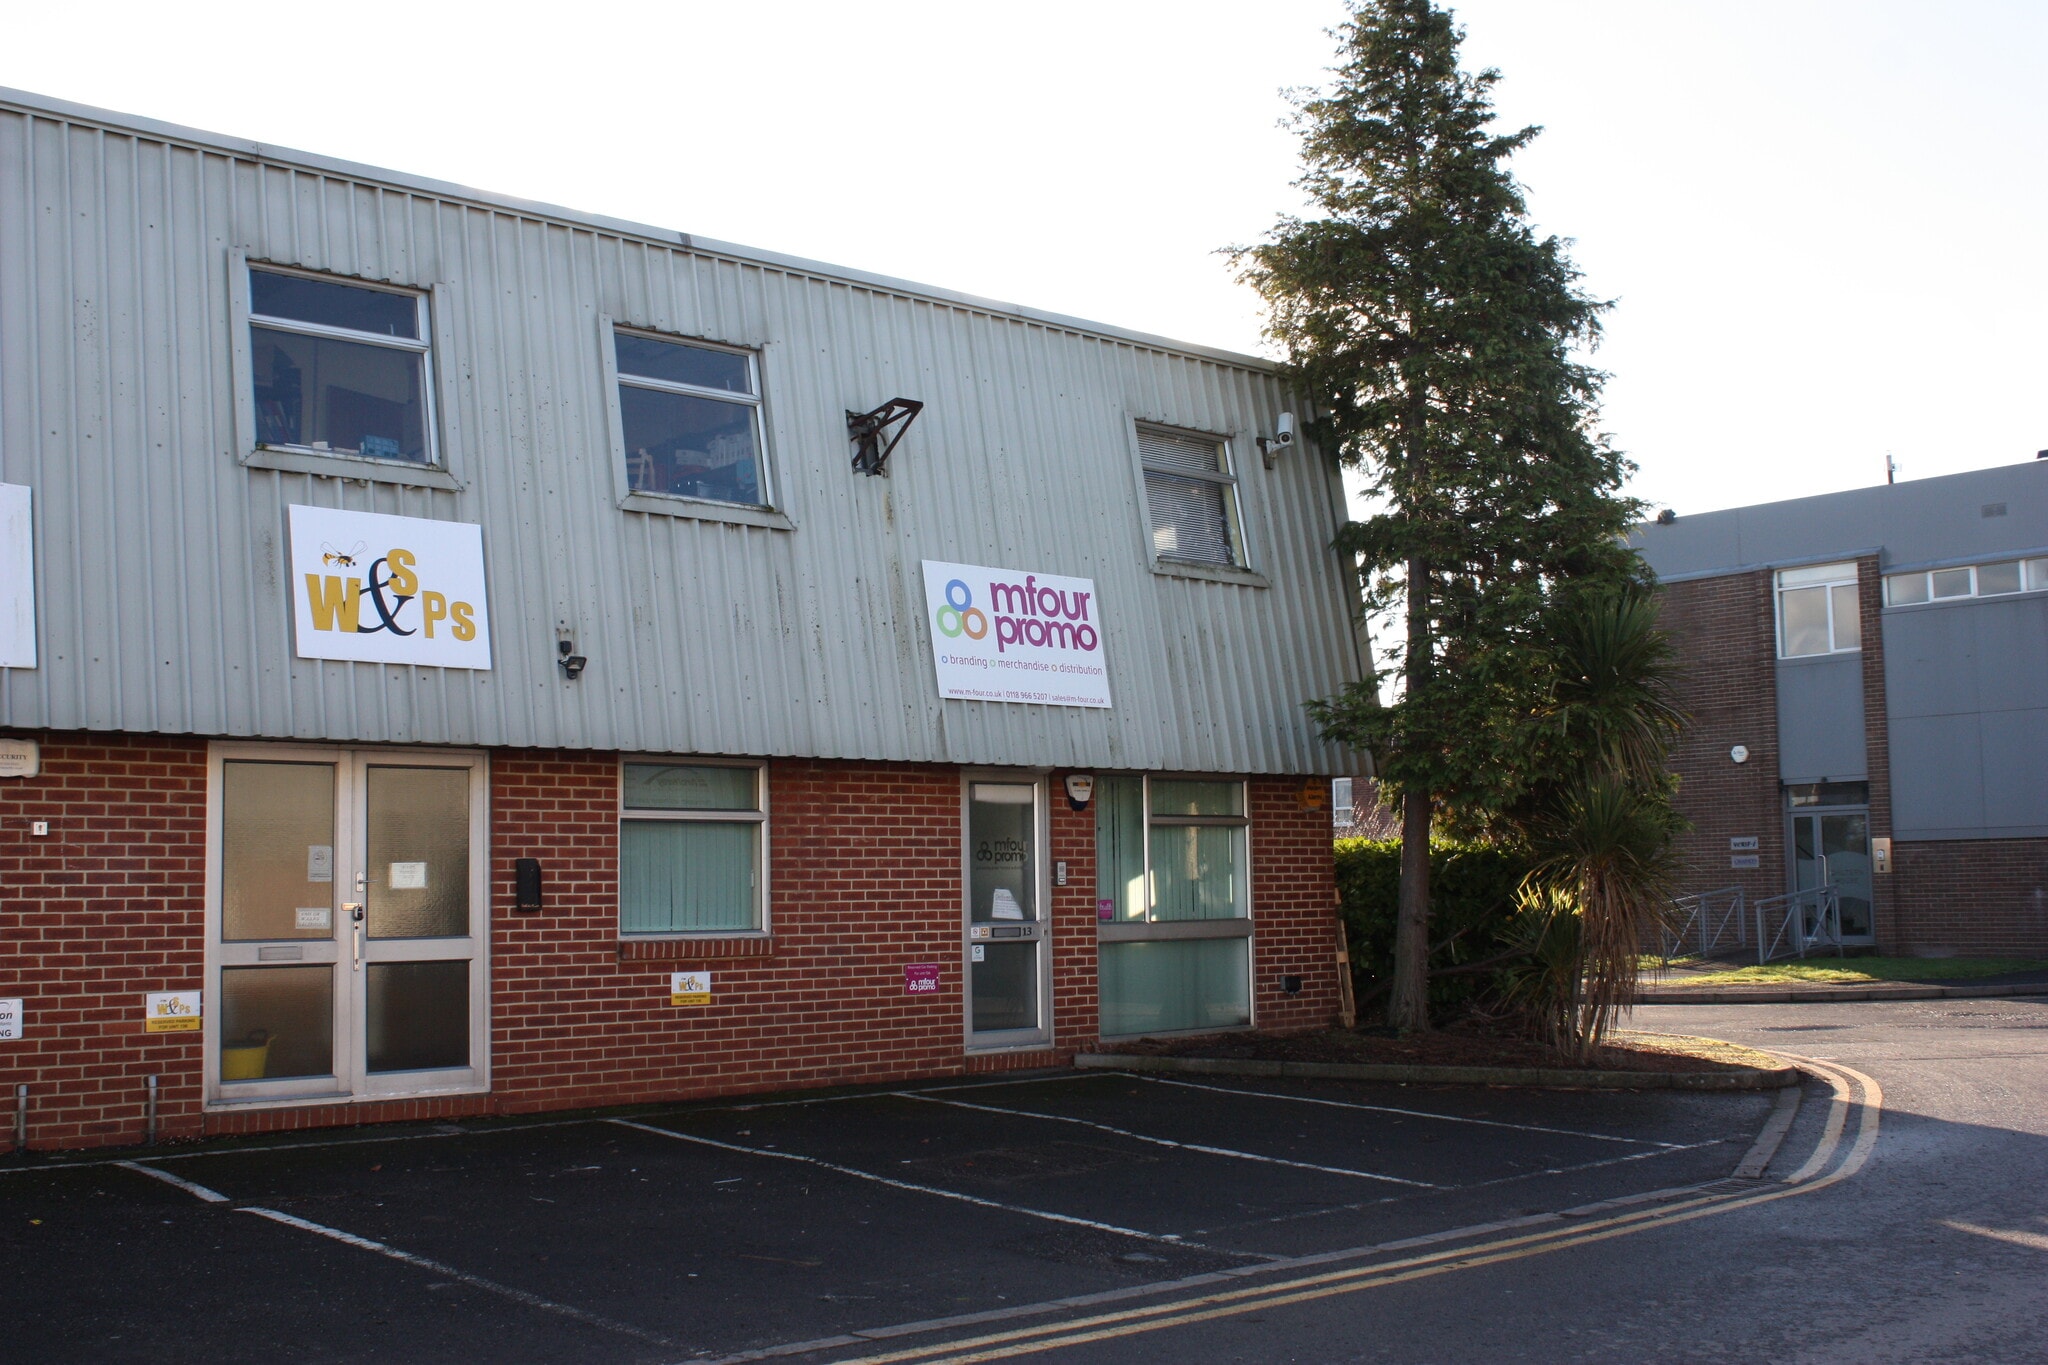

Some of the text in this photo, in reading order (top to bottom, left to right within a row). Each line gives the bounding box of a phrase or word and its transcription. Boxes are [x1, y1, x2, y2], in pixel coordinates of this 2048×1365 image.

[990, 575, 1090, 621] mfour
[994, 615, 1098, 652] promo
[950, 654, 1103, 675] branding merchandise distribution
[948, 687, 1002, 697] www.m-four.co.uk
[1006, 690, 1019, 699] 0118
[1020, 692, 1032, 700] 966
[1033, 692, 1048, 701] 5207
[994, 851, 1029, 864] promo
[1022, 926, 1032, 936] 13
[918, 977, 936, 986] mfour
[918, 984, 936, 992] promo
